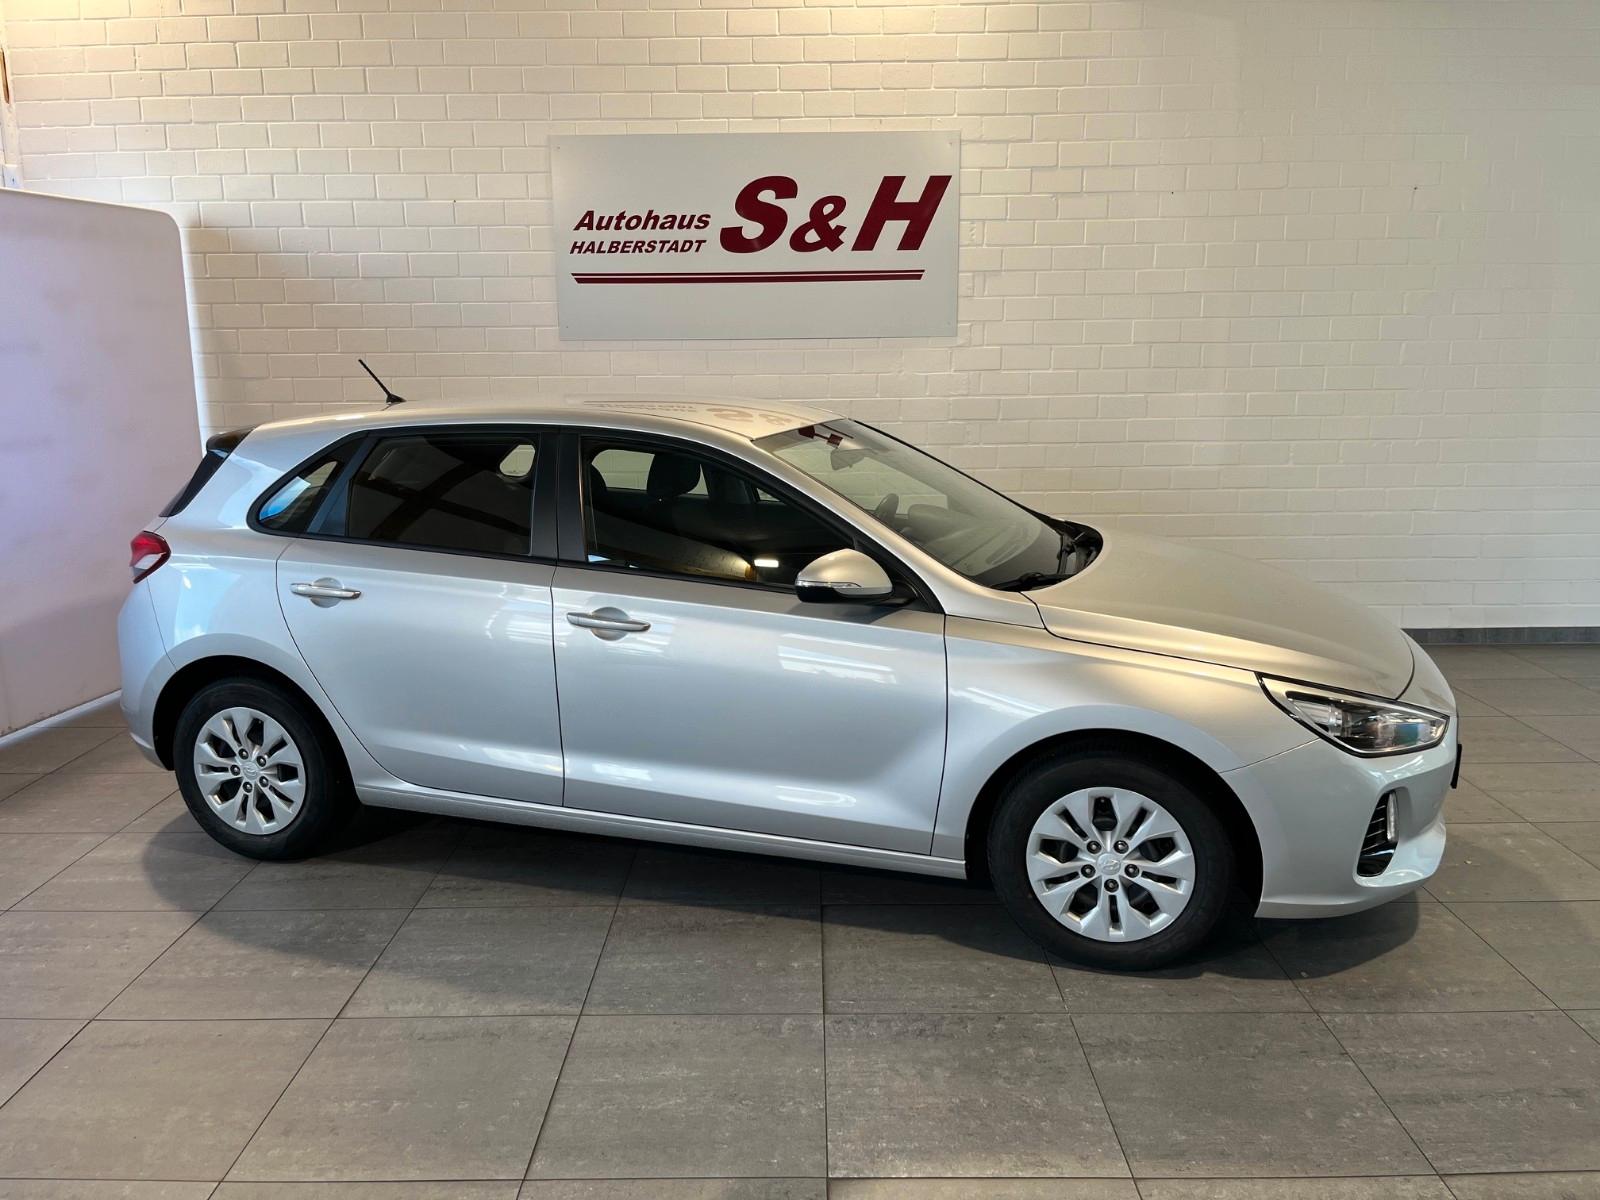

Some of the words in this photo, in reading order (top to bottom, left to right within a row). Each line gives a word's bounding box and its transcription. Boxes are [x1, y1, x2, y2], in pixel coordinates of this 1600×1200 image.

[573, 209, 711, 231] Autohaus
[719, 175, 953, 254] S&H
[569, 239, 707, 255] HALBERSTADT
